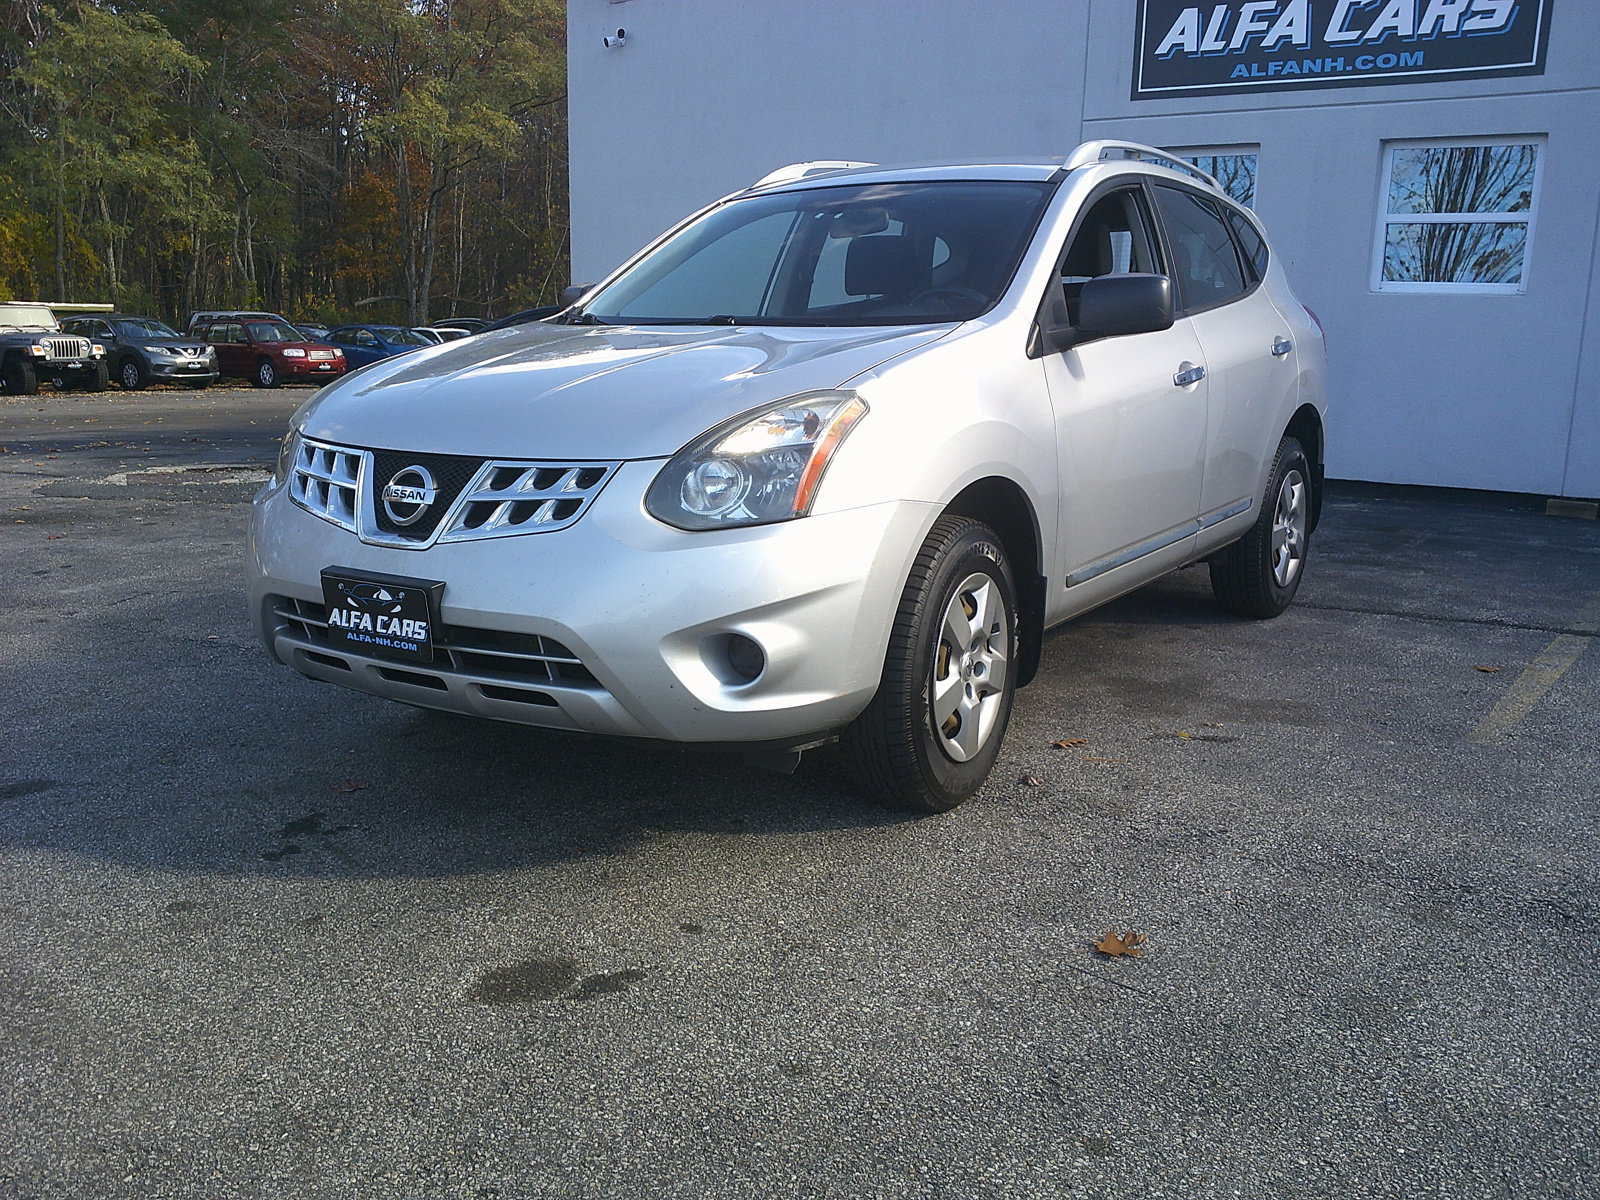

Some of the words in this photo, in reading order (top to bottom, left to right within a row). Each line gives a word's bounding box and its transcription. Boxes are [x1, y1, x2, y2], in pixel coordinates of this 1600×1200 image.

[1154, 0, 1310, 57] ALFA
[1323, 0, 1517, 45] CARS
[1230, 51, 1424, 78] ALFANH.COM
[384, 486, 427, 501] NISSAN
[328, 607, 374, 632] ALFA
[376, 614, 427, 641] CARS
[347, 632, 418, 652] ALFA-NH.COM
